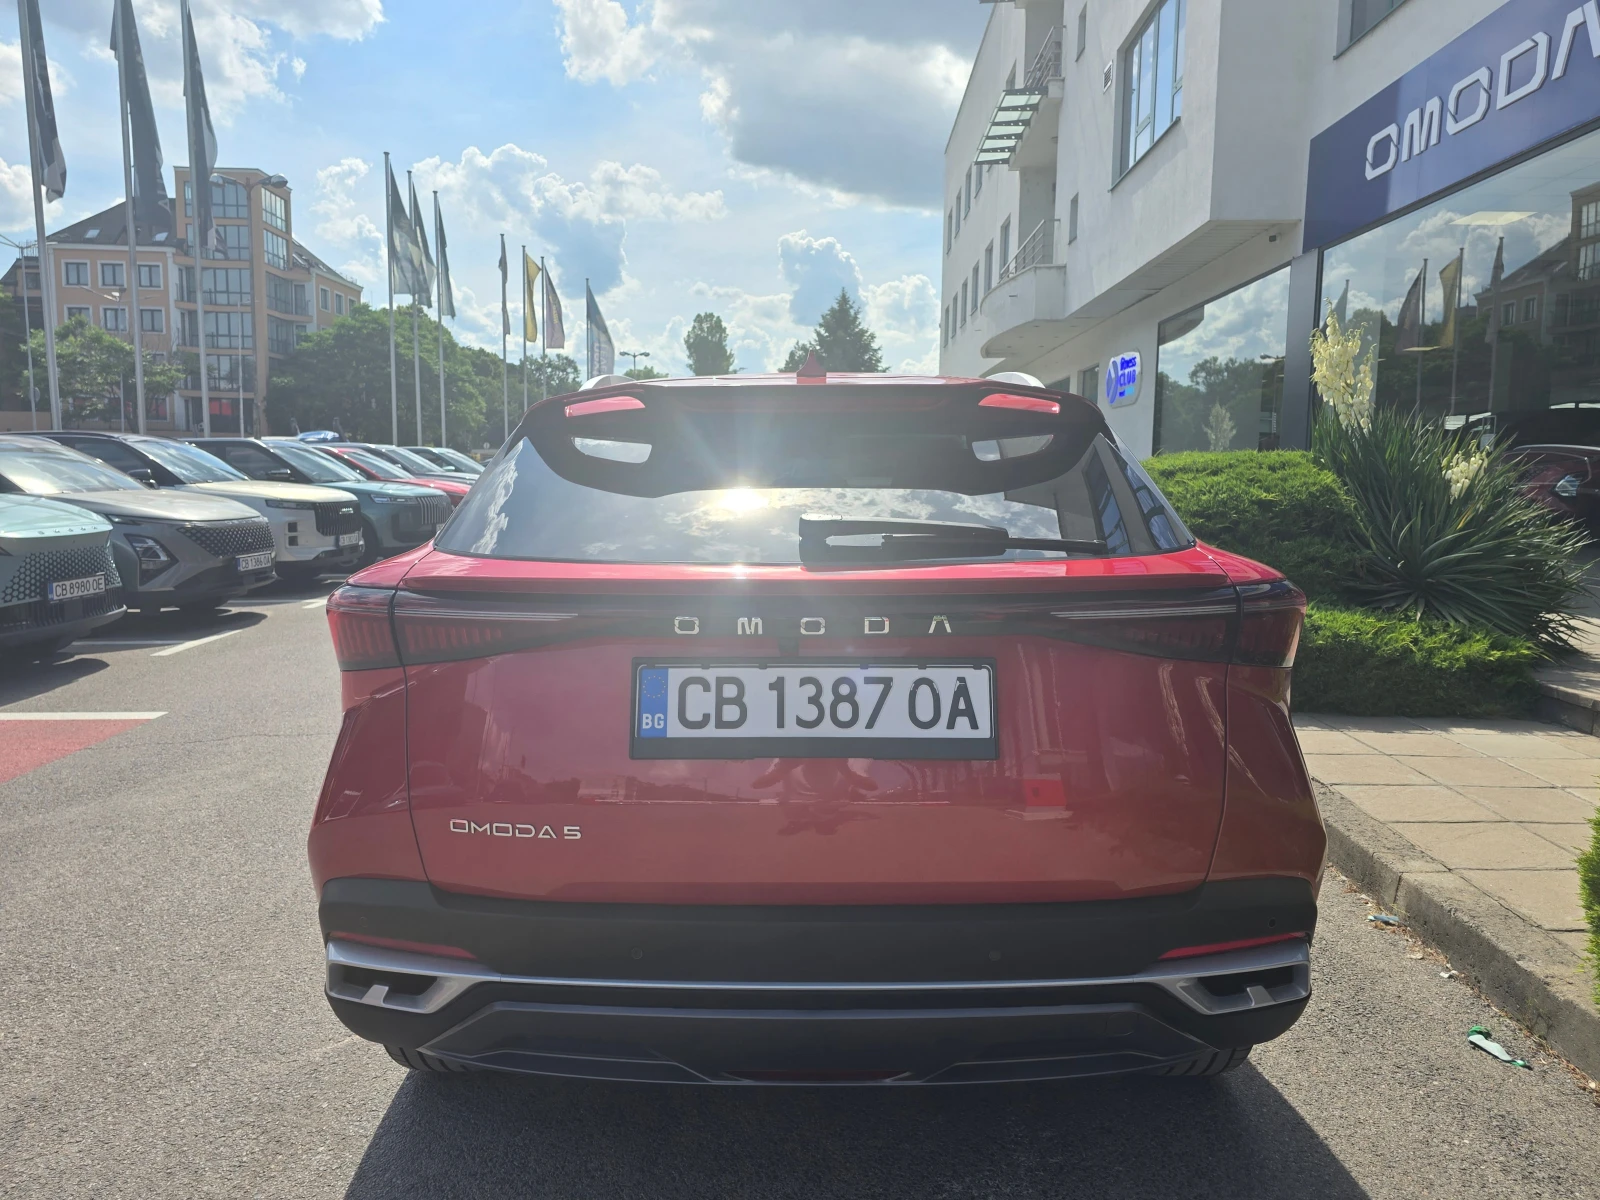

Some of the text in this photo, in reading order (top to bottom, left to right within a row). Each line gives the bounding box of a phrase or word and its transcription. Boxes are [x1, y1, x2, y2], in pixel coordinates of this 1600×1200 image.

[1365, 0, 1600, 181] OMODA
[55, 583, 68, 597] CB
[69, 579, 91, 594] 8980
[92, 578, 103, 591] OE
[674, 615, 952, 635] OMODA
[677, 676, 980, 730] CB 1387 OA
[642, 713, 665, 730] BG
[450, 818, 582, 840] OMODA 5
